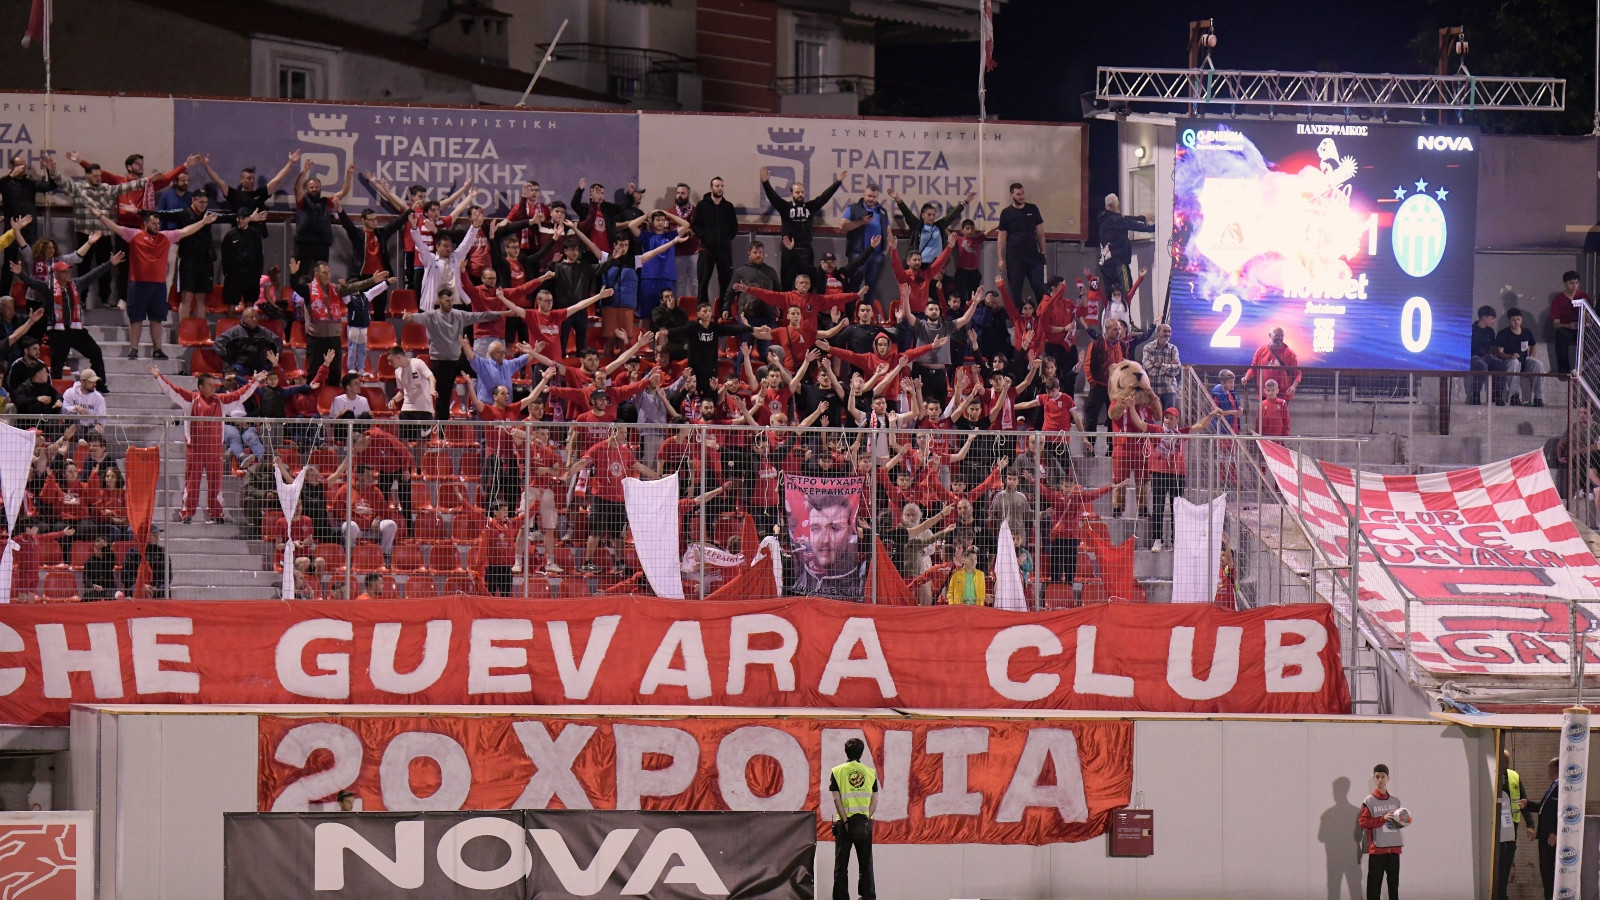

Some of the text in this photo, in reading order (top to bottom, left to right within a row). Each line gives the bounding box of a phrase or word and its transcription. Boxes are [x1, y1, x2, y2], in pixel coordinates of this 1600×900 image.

[374, 115, 557, 129] ΣΥΝΕΤΑΙΡΙΣΤΙΚΗ
[375, 134, 499, 160] ΤΡΑΠΕΖΑ
[1417, 135, 1474, 151] NOVA
[832, 148, 950, 171] ΤΡΑΠΕΖΑ
[376, 160, 529, 186] ΚΕΝΤΡΙΚΗΣ
[832, 173, 977, 196] ΚΕΝΤΡΙΚΗΣ
[1209, 293, 1243, 348] 2
[1400, 296, 1433, 353] 0
[1369, 510, 1465, 526] CLUB
[1360, 522, 1513, 549] CHE
[1334, 536, 1566, 568] GUEVARA
[274, 614, 899, 700] GUEVARA
[985, 618, 1329, 701] CLUB
[271, 721, 472, 812] 20
[314, 816, 731, 896] NOVA
